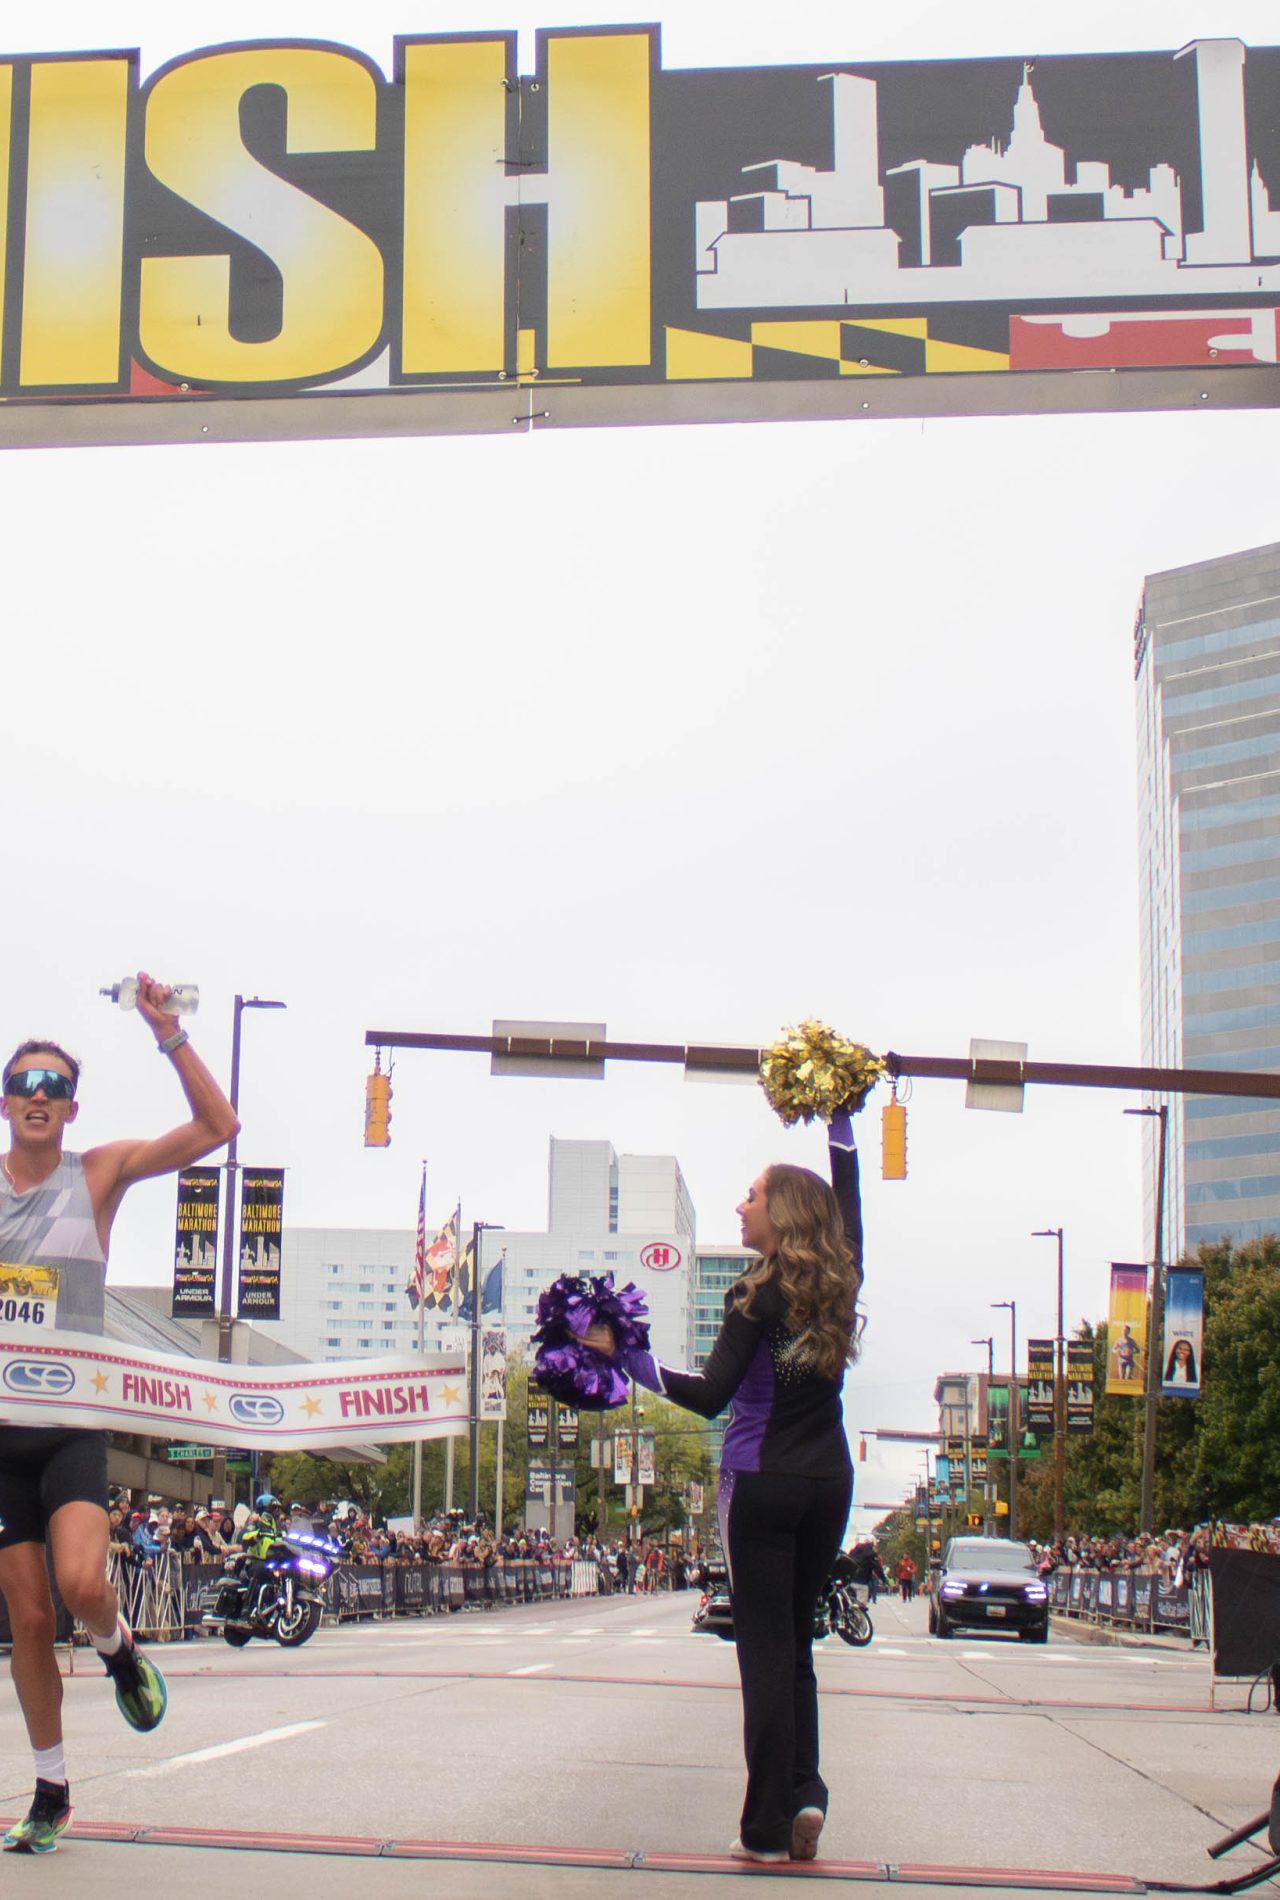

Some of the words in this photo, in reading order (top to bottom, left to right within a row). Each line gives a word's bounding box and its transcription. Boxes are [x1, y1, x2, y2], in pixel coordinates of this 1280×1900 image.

[177, 1202, 217, 1218] BALTIMORE
[241, 1203, 281, 1219] BALTIMORE
[177, 1217, 217, 1231] MARATHON
[241, 1218, 280, 1233] MARATHON
[121, 1373, 193, 1411] FINISH
[338, 1384, 430, 1418] FINISH
[176, 1449, 204, 1458] CHARLES
